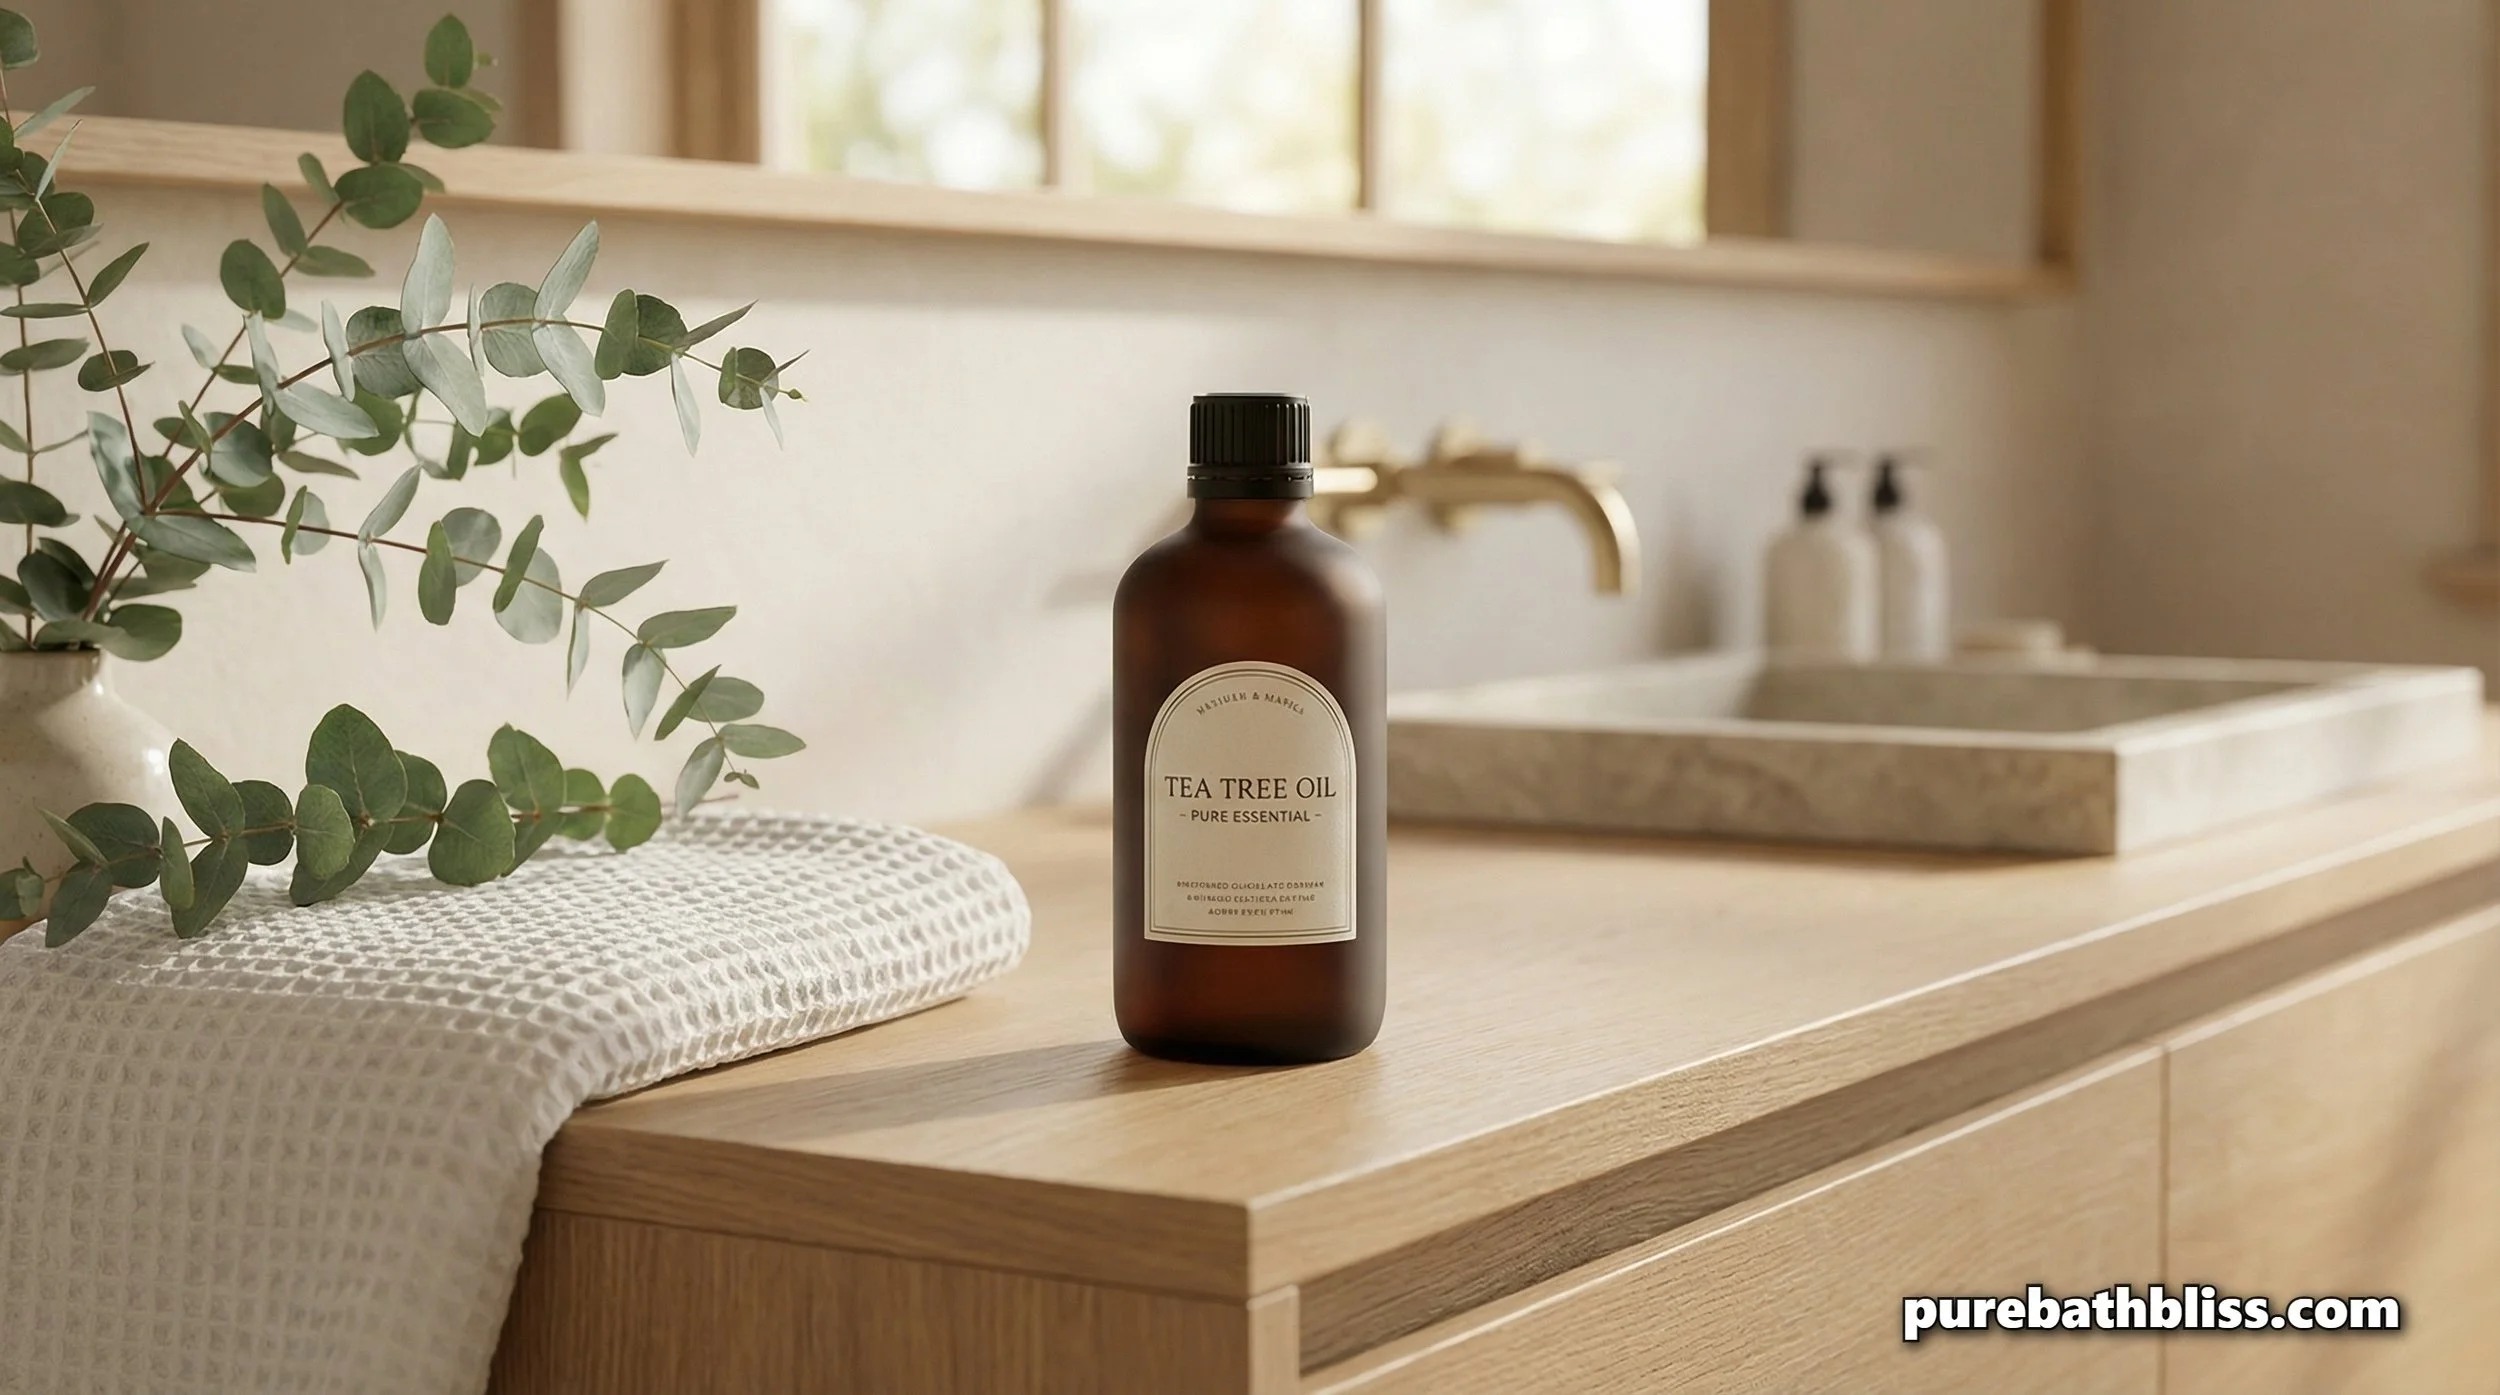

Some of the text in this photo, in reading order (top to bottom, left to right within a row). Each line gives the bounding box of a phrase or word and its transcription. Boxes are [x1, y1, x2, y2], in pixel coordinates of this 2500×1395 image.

[1164, 776, 1337, 799] TEA TREE OIL
[1191, 809, 1311, 823] PURE ESSENTIAL
